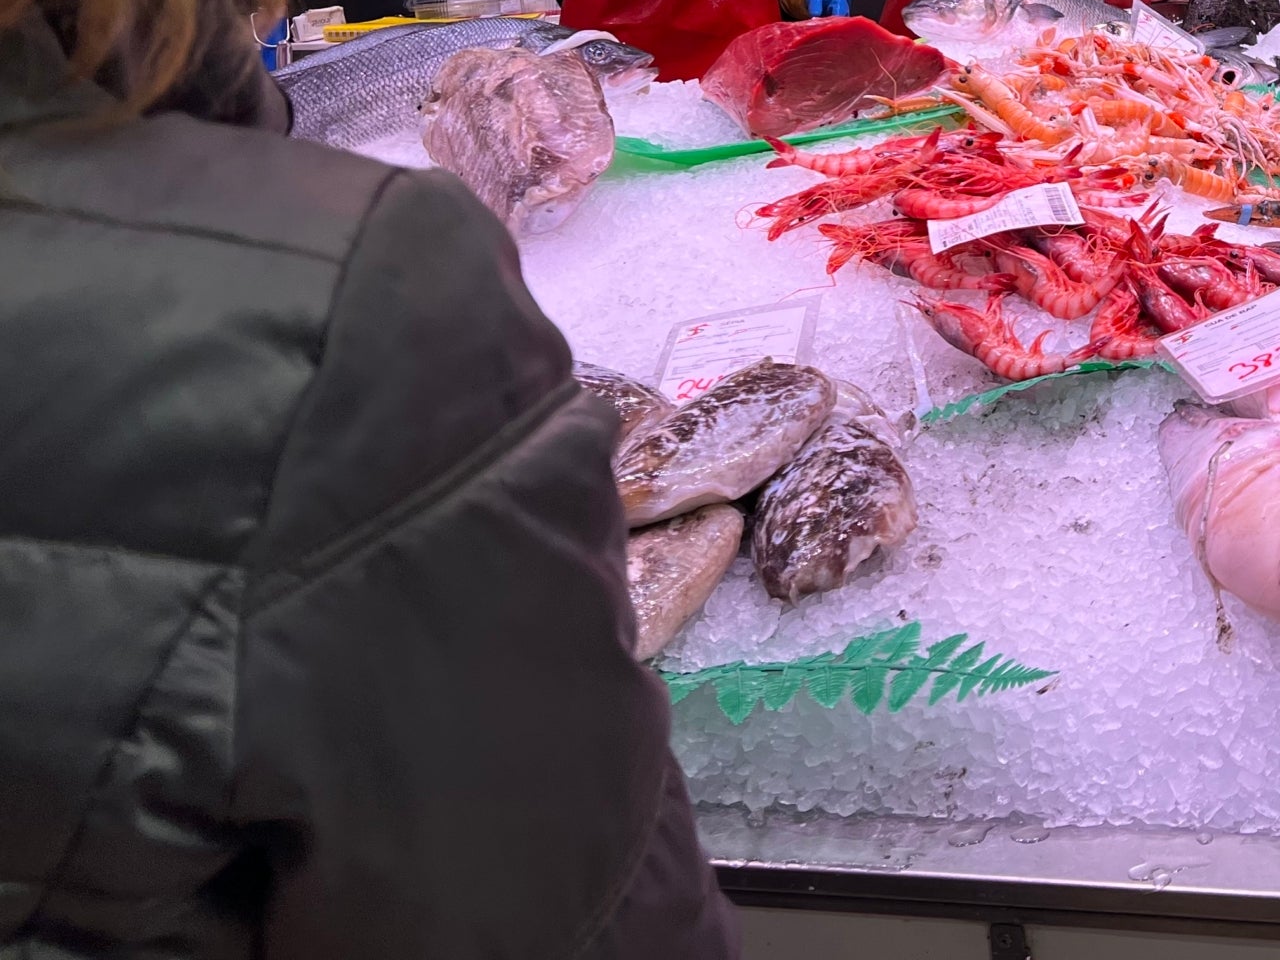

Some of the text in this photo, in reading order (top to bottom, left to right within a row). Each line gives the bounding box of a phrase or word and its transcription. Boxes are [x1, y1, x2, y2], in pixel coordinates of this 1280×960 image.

[1204, 304, 1258, 329] CUA DE RAP
